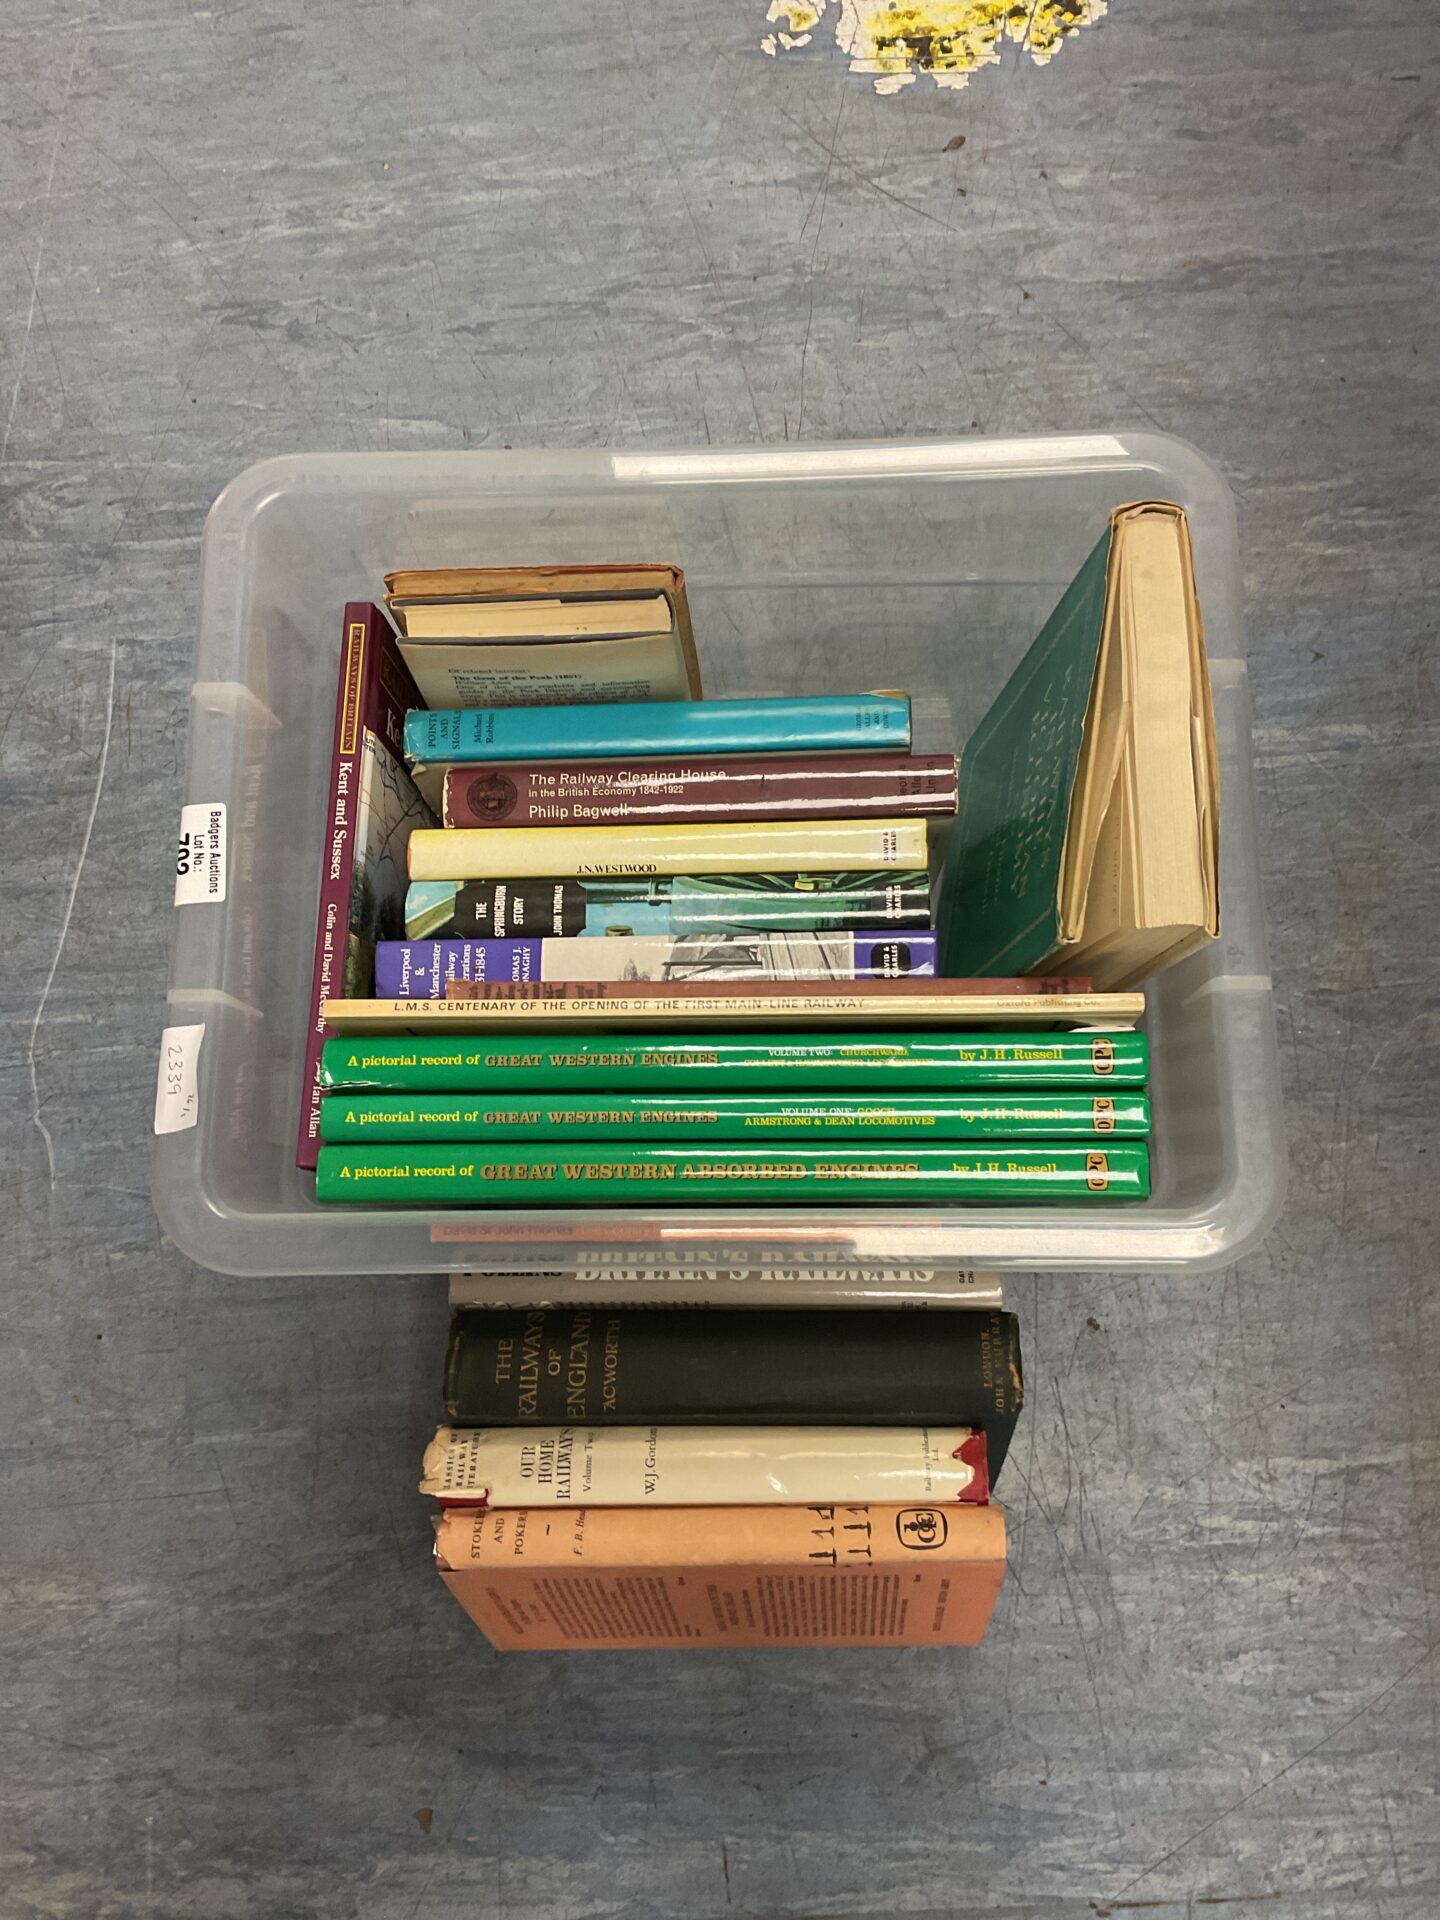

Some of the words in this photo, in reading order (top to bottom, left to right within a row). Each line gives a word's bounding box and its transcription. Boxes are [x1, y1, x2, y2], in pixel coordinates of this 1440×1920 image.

[345, 703, 355, 750] BRITAIN
[428, 712, 438, 749] POINTS
[440, 718, 449, 740] AND
[338, 761, 353, 795] Kent
[528, 788, 538, 798] in
[540, 788, 555, 798] the
[558, 787, 590, 798] British
[592, 786, 636, 799] Economy
[638, 785, 684, 796] 1842-1922
[530, 774, 556, 786] The
[560, 773, 613, 789] Railway
[617, 770, 676, 786] Clearing
[681, 769, 726, 781] House
[335, 799, 348, 825] and
[529, 804, 569, 823] Philip
[573, 803, 629, 821] Bagwell
[193, 834, 205, 850] Lot
[207, 811, 222, 849] Badgers
[330, 830, 347, 881] Sussex
[208, 852, 221, 894] Auctions
[475, 901, 487, 920] THE
[494, 884, 507, 937] SPRINGBURN
[513, 896, 524, 925] STORY
[553, 884, 564, 908] THOMAS
[325, 903, 337, 930] Colin
[553, 909, 563, 936] JOHN
[324, 933, 335, 951] and
[321, 952, 333, 984] David
[399, 947, 413, 996] Liverpool
[415, 966, 425, 976] &
[430, 943, 442, 999] Manchester
[445, 951, 459, 990] ailway
[462, 943, 471, 982] erations
[474, 946, 486, 983] 31-1845
[512, 953, 520, 983] OMAS
[523, 946, 531, 983] NAGHY
[315, 984, 331, 1034] McCthy
[394, 1001, 432, 1011] L.M.S.
[438, 1001, 515, 1011] CENTENARY
[521, 1001, 537, 1011] OF
[541, 1001, 566, 1010] THE
[572, 1000, 628, 1011] OPENING
[634, 1000, 650, 1010] OF
[654, 1000, 679, 1010] THE
[685, 999, 719, 1009] FIRST
[804, 998, 865, 1009] RAILWAY
[347, 1055, 358, 1066] A
[361, 1055, 416, 1069] pictorial
[420, 1055, 462, 1066] record
[466, 1054, 480, 1066] of
[484, 1054, 543, 1067] GREAT
[549, 1054, 636, 1067] WESTERN
[640, 1053, 719, 1066] ENGINES
[768, 1048, 808, 1057] VOLUME
[959, 1049, 976, 1062] by
[1013, 1048, 1063, 1060] Russell
[167, 1045, 183, 1095] 2339
[311, 1085, 322, 1104] Ian
[308, 1107, 320, 1138] Allan
[345, 1112, 355, 1123] A
[359, 1111, 415, 1125] pictorial
[419, 1111, 460, 1122] record
[464, 1111, 478, 1122] of
[483, 1111, 541, 1124] GREAT
[547, 1111, 634, 1123] WESTERN
[639, 1110, 718, 1123] ENGINES
[744, 1116, 811, 1126] ARMSTRONG
[813, 1117, 821, 1126] &
[825, 1116, 855, 1126] DEAN
[858, 1116, 935, 1126] LOCOMOTIVES
[781, 1107, 826, 1116] VOLUME
[960, 1108, 975, 1121] by
[1013, 1108, 1063, 1120] Russell
[340, 1166, 351, 1177] A
[354, 1166, 410, 1180] pictorial
[413, 1166, 455, 1177] record
[459, 1165, 474, 1176] of
[480, 1164, 557, 1180] GREAT
[562, 1163, 677, 1180] WESTERN
[680, 1163, 808, 1180] ABSORBED
[814, 1162, 920, 1180] ENGINES
[1007, 1162, 1057, 1174] Russell
[495, 1338, 513, 1384] THE
[518, 1311, 545, 1418] RAILWAYS
[547, 1348, 561, 1376] OF
[566, 1311, 591, 1418] ENGLAND
[603, 1319, 620, 1412] ACWORTH
[583, 1431, 594, 1451] Two
[443, 1448, 456, 1489] LASSICS
[467, 1430, 480, 1489] ITERATURE
[519, 1446, 536, 1478] OUR
[538, 1439, 555, 1484] HOME
[556, 1427, 574, 1500] RAILWAYS
[582, 1454, 593, 1492] Volume
[493, 1518, 505, 1544] AND
[575, 1510, 586, 1528] Hea
